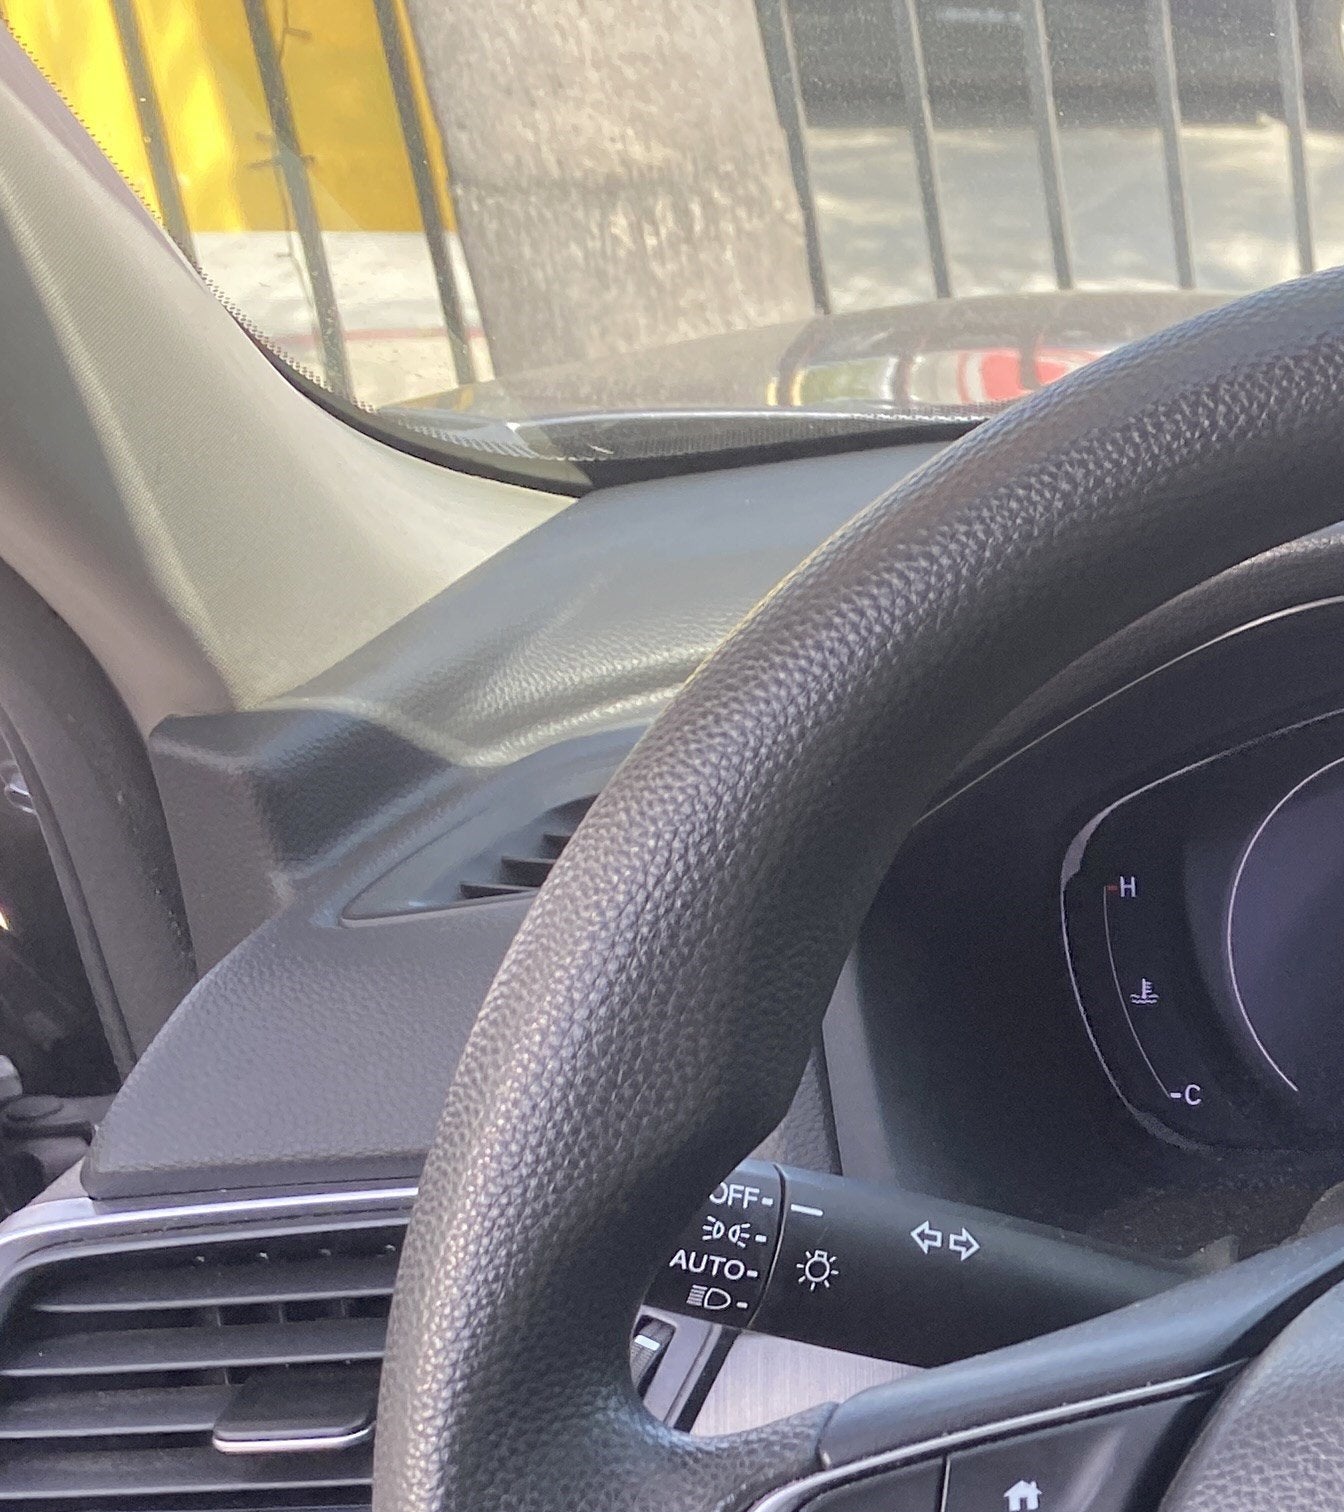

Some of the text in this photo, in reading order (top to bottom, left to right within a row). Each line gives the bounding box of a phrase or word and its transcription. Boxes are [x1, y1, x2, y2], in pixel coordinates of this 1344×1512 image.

[1120, 876, 1137, 897] H
[1184, 1085, 1202, 1105] C
[709, 1182, 760, 1209] OFF
[669, 1249, 745, 1280] AUTO
